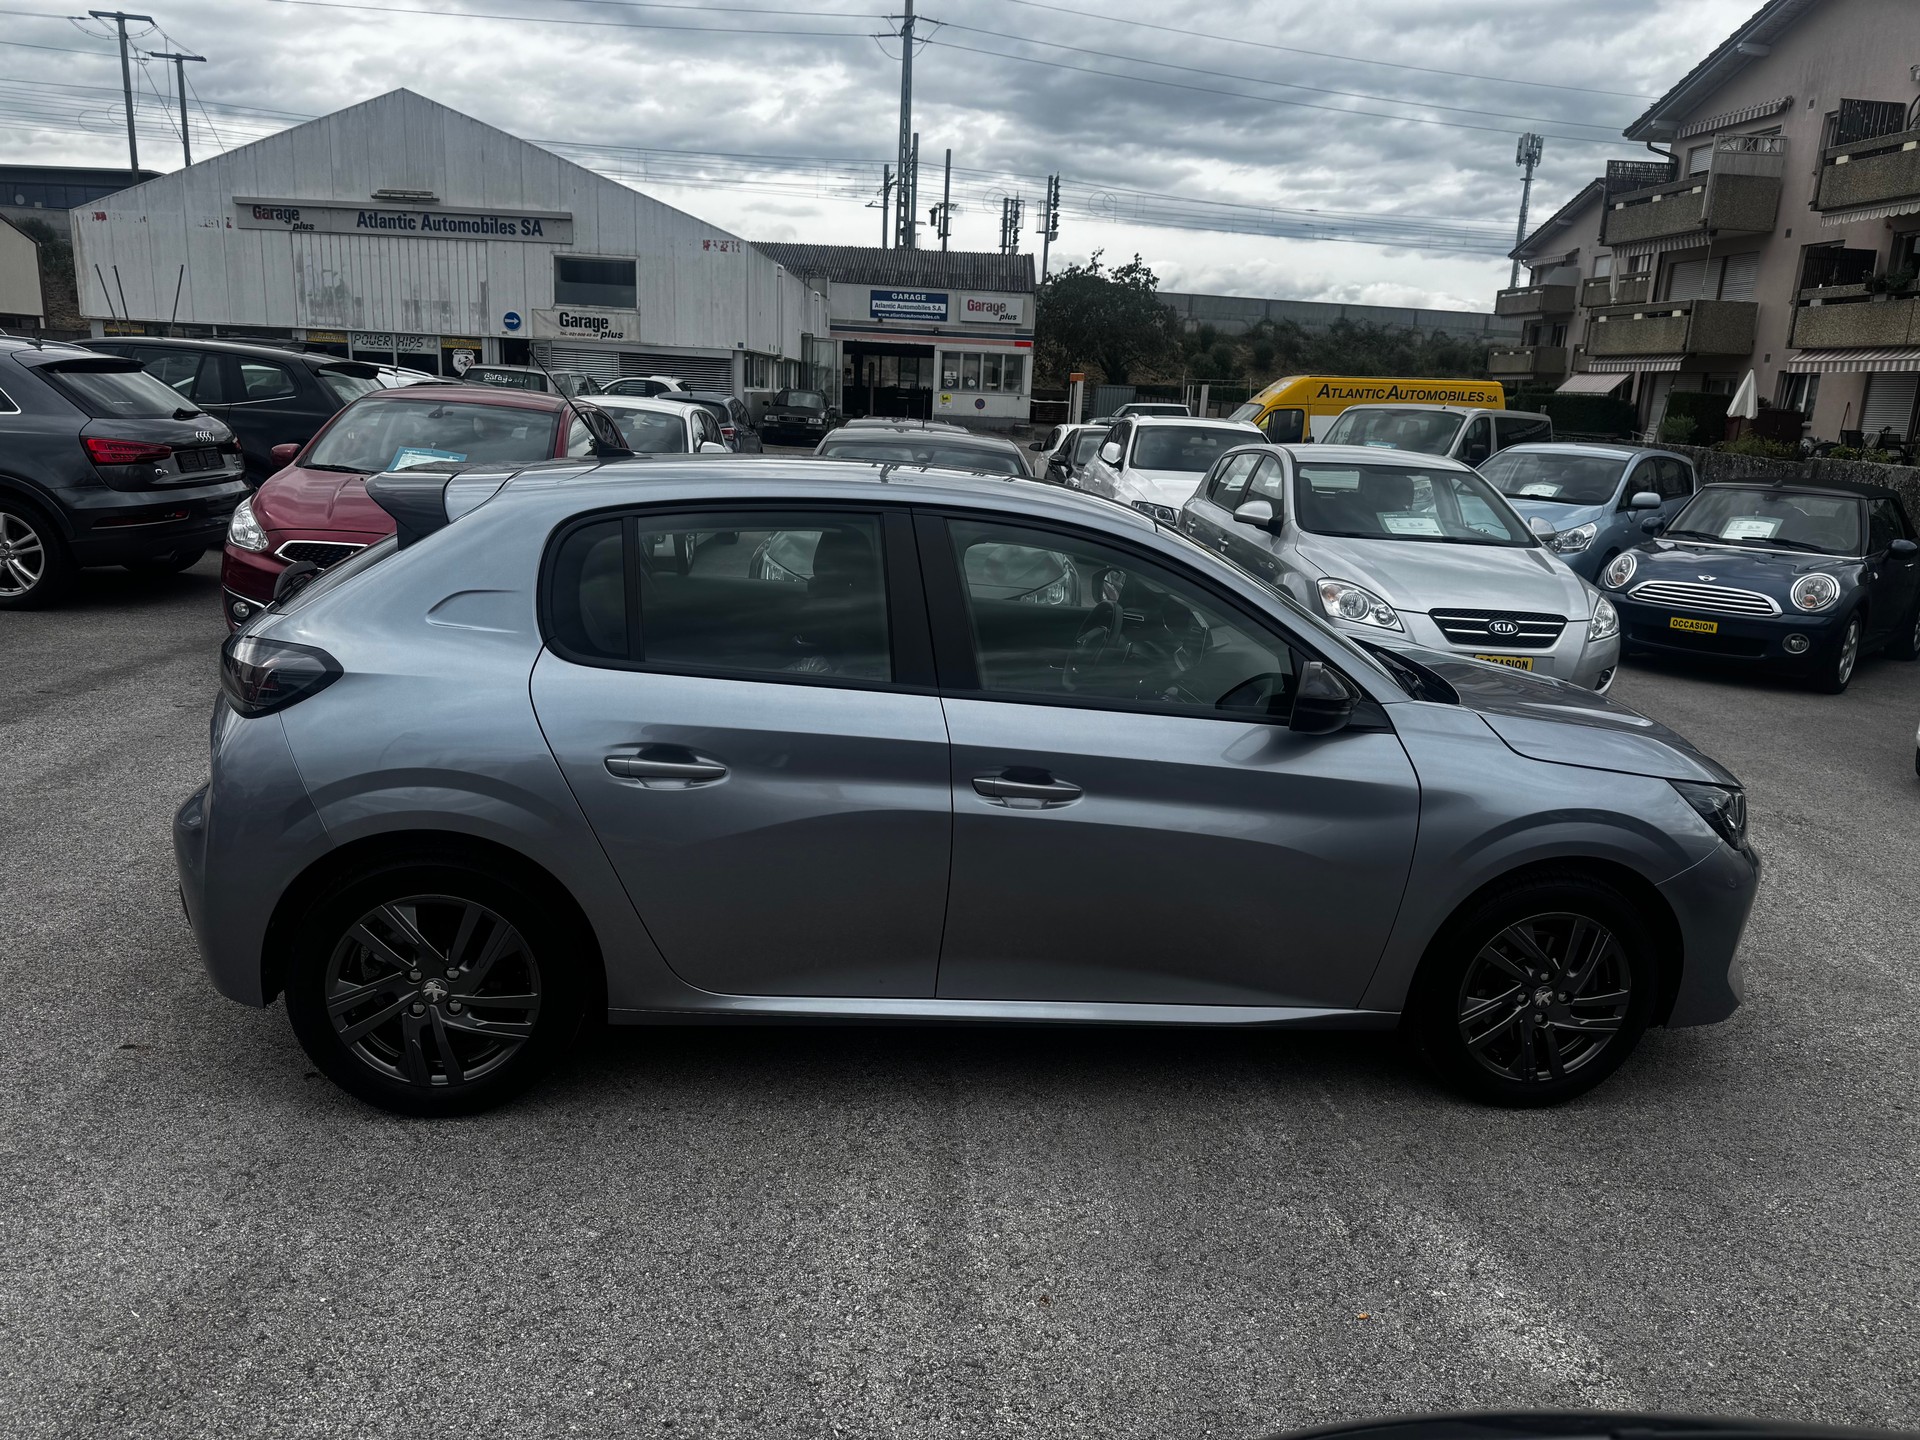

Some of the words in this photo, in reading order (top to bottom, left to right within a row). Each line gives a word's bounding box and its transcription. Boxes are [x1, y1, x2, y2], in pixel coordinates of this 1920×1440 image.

[252, 205, 300, 224] Garage
[292, 221, 315, 231] plus
[356, 211, 416, 230] Atlantic
[421, 214, 516, 235] Automobiles
[520, 219, 543, 236] SA
[891, 293, 927, 301] GARAGE
[874, 302, 896, 310] Atlantic
[896, 303, 931, 311] Automobiles
[967, 299, 1006, 315] Garage
[559, 312, 609, 333] Garage
[999, 313, 1017, 321] plus
[600, 330, 624, 340] plus
[1316, 384, 1386, 399] ATLANTIC
[1386, 385, 1485, 402] AUTOMOBILES
[1486, 395, 1498, 403] SA
[1493, 622, 1514, 633] KIA
[1672, 618, 1714, 631] OCCASION
